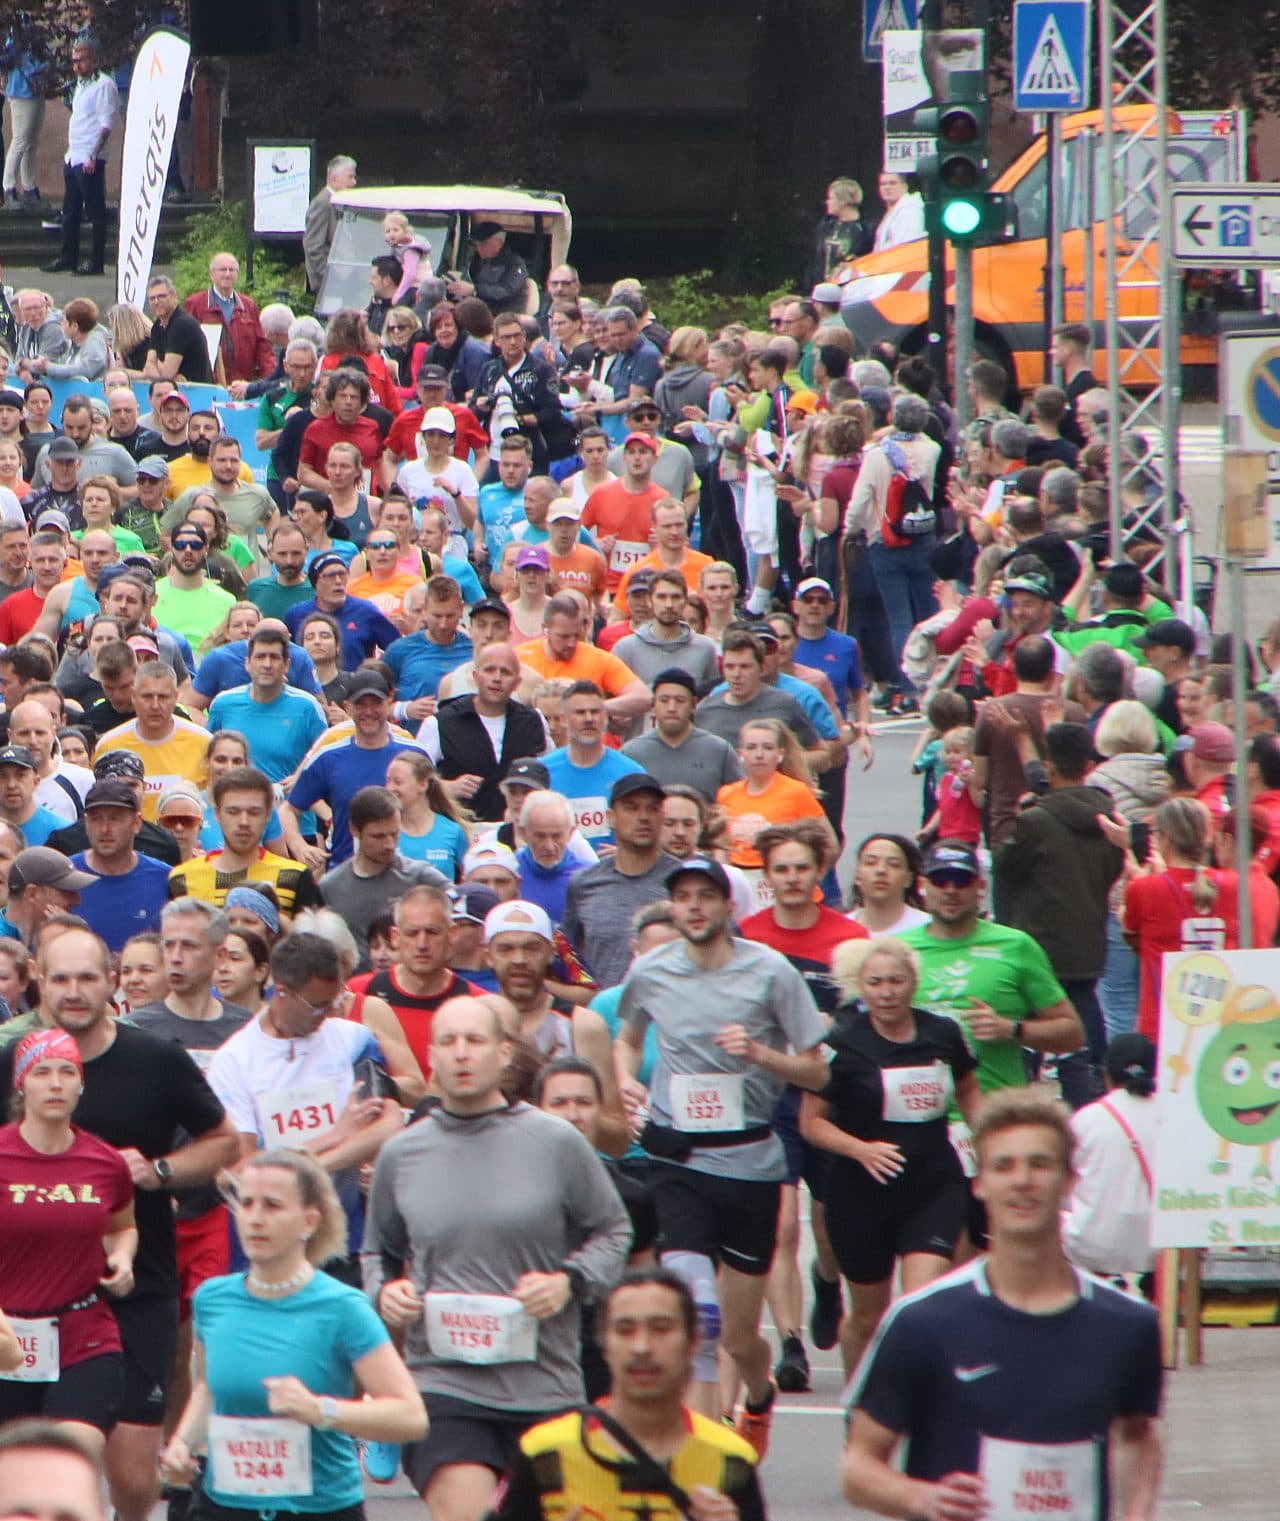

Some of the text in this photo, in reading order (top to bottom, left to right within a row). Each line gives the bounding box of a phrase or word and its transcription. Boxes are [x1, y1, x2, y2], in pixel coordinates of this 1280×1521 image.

[123, 102, 166, 304] energis
[271, 1102, 336, 1135] 1431
[686, 1105, 724, 1119] 1327
[226, 1440, 288, 1459] NATALIE
[233, 1461, 284, 1478] 1244
